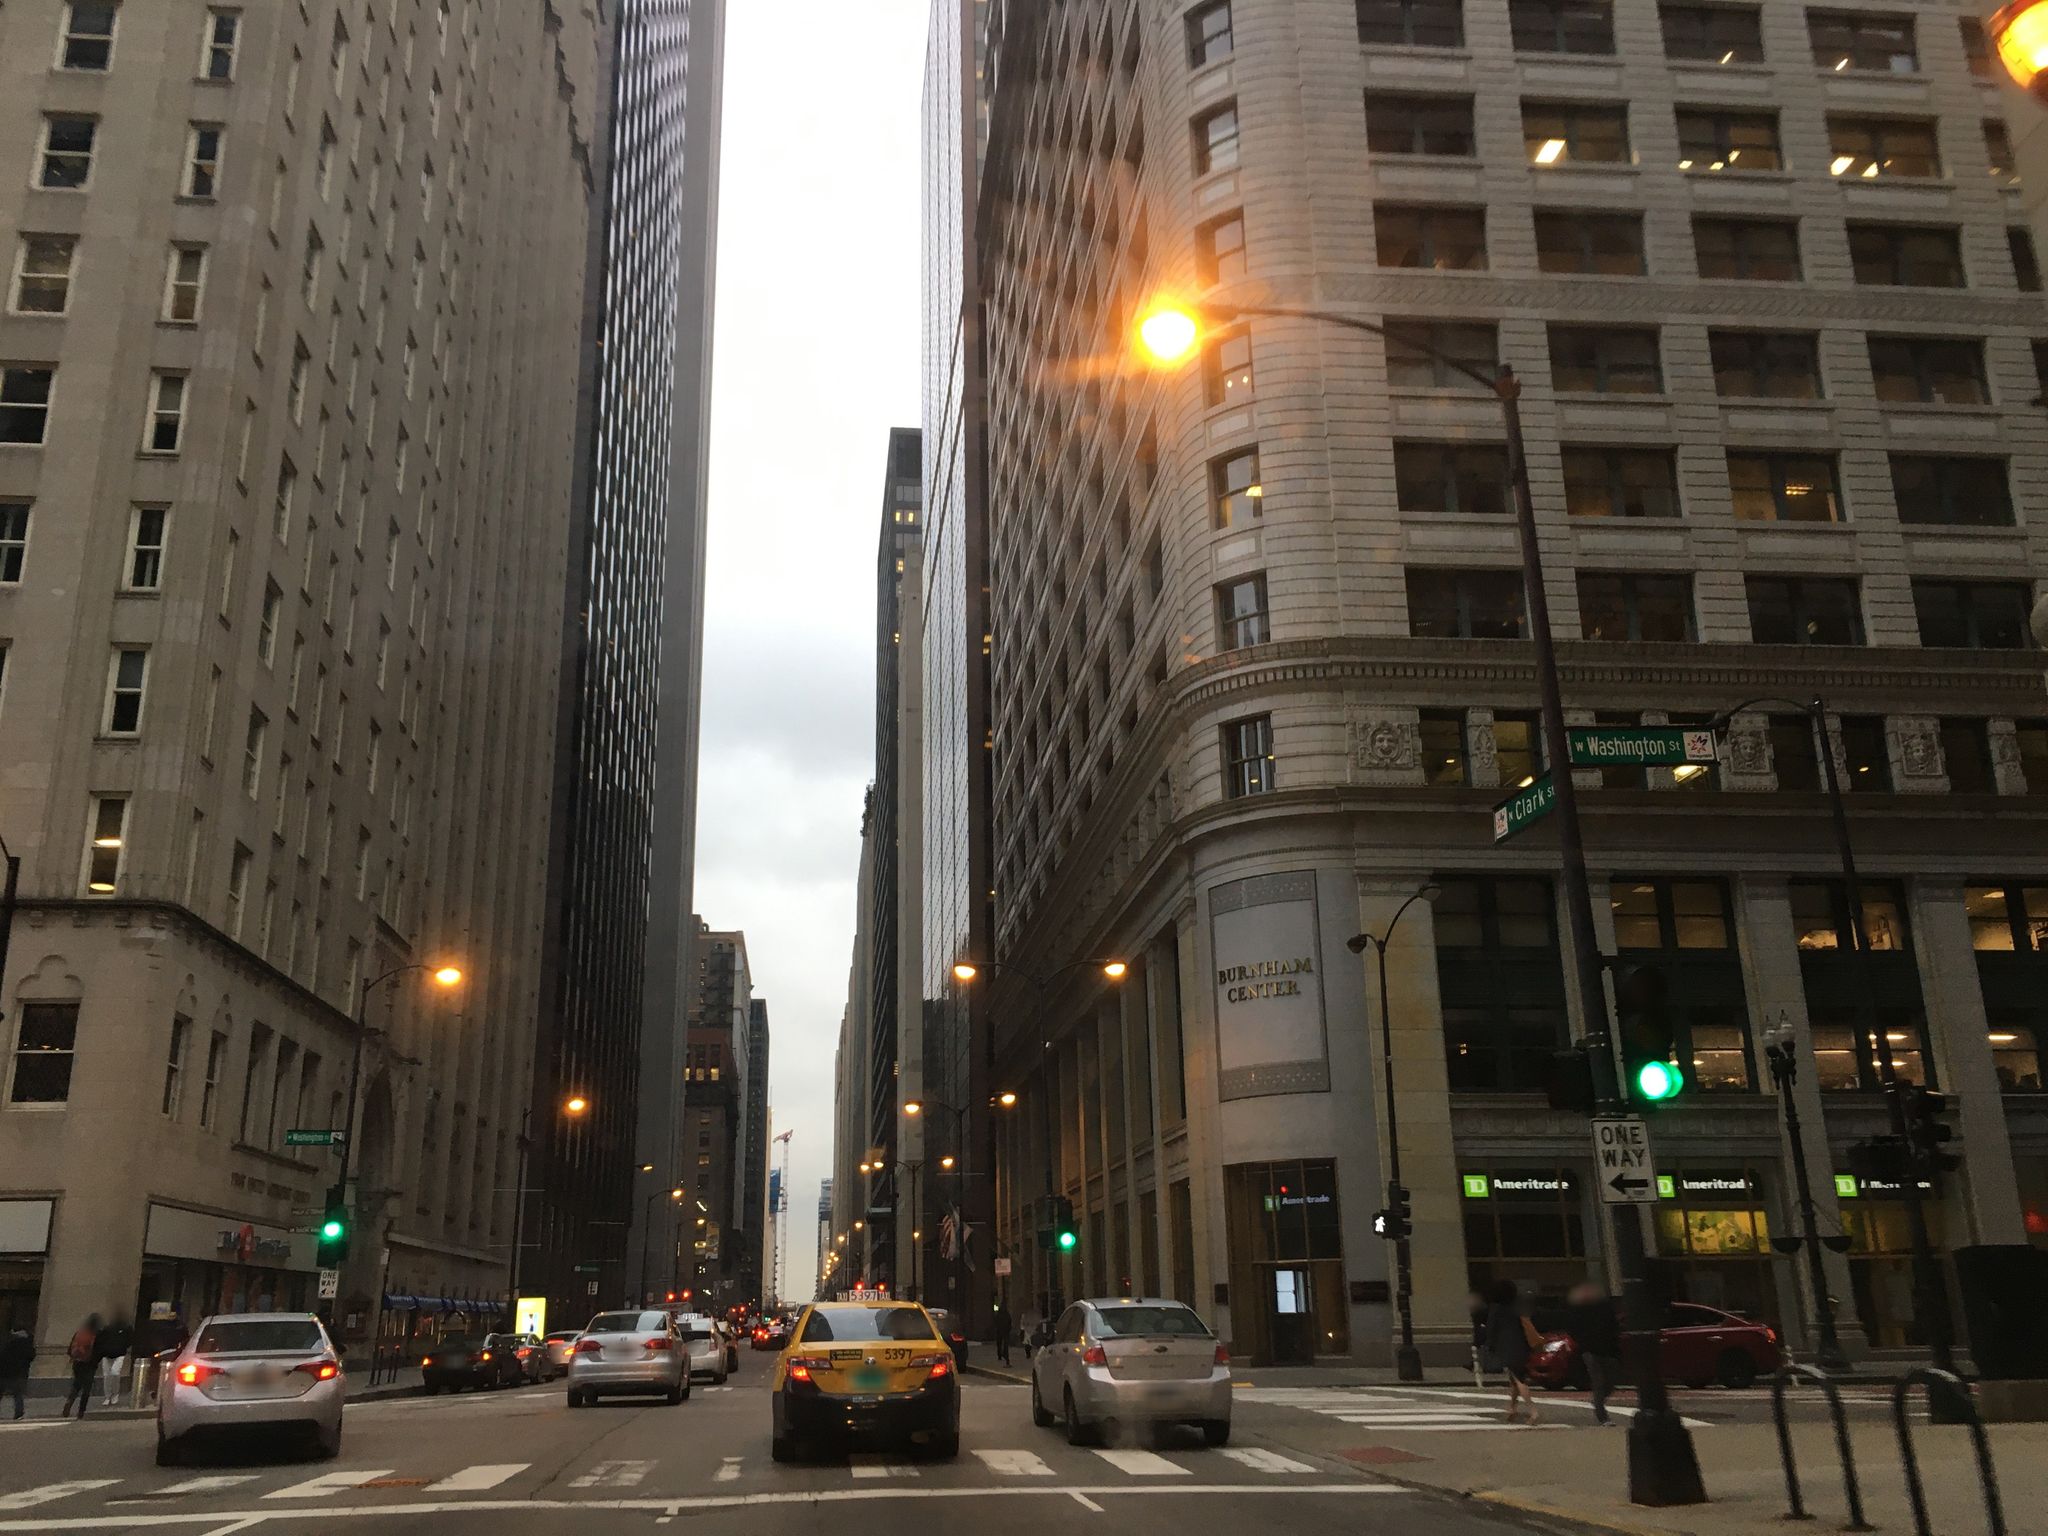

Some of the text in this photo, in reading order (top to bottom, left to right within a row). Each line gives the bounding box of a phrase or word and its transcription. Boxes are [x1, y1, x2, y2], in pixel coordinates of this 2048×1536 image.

[1574, 736, 1681, 762] W Washington St
[1515, 788, 1545, 820] Clark
[1218, 957, 1314, 985] BURNHAM
[1227, 980, 1301, 1004] CENTER
[1600, 1126, 1642, 1145] ONE
[1602, 1148, 1645, 1168] WAY
[1464, 1178, 1569, 1194] TD Ameritrade
[1835, 1178, 1856, 1194] TD
[1281, 1194, 1330, 1205] Amertrade
[321, 1279, 336, 1287] WAY
[322, 1271, 337, 1279] ONE
[851, 1290, 877, 1301] 5397
[885, 1348, 912, 1360] 5397
